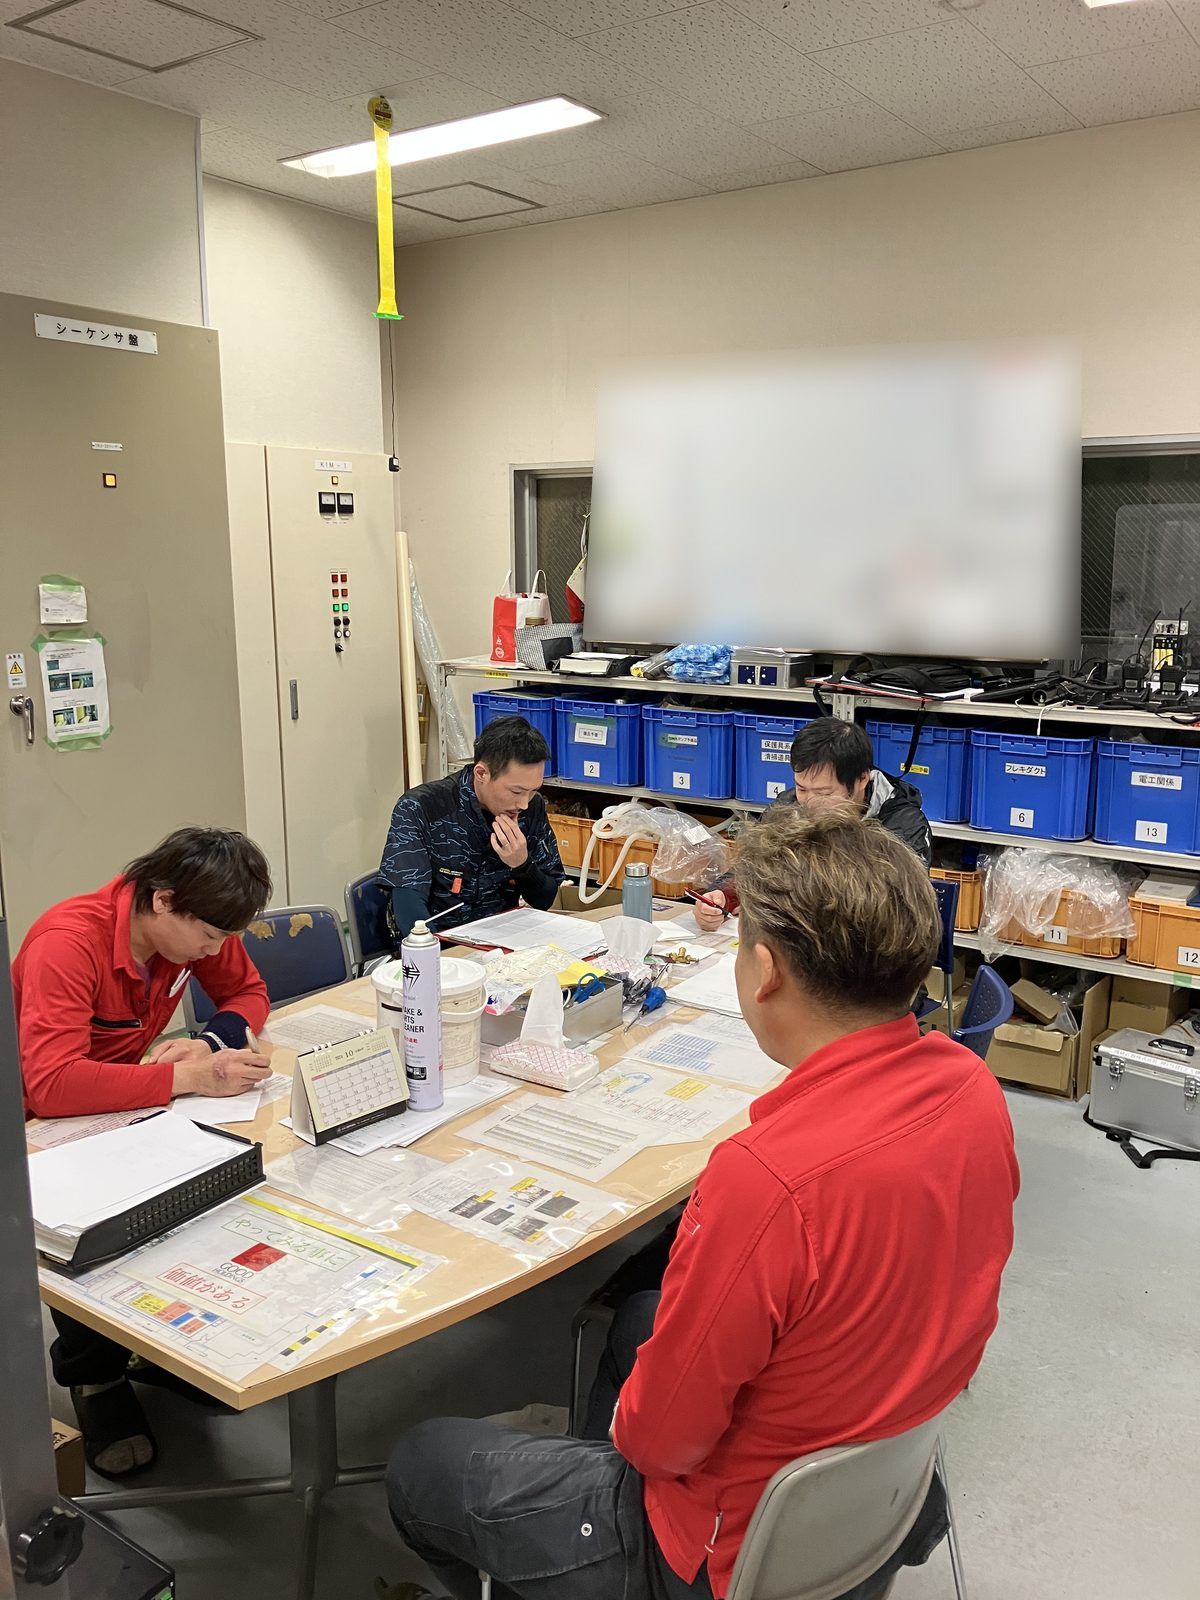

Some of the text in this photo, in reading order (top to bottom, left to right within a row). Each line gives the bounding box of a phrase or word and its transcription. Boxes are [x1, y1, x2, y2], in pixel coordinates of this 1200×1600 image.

[56, 322, 139, 347] シーケンサ盤
[589, 764, 595, 774] 2
[1006, 764, 1046, 776] フレキダクト
[679, 776, 684, 786] 3
[1138, 774, 1175, 787] 電工関係
[773, 786, 779, 794] 4
[1018, 812, 1025, 823] 6
[1146, 827, 1158, 837] 13
[1050, 929, 1061, 940] 11
[1185, 951, 1199, 964] 12
[345, 1050, 354, 1058] 10
[220, 1262, 254, 1278] GOOD
[165, 1267, 251, 1309] 価値がある
